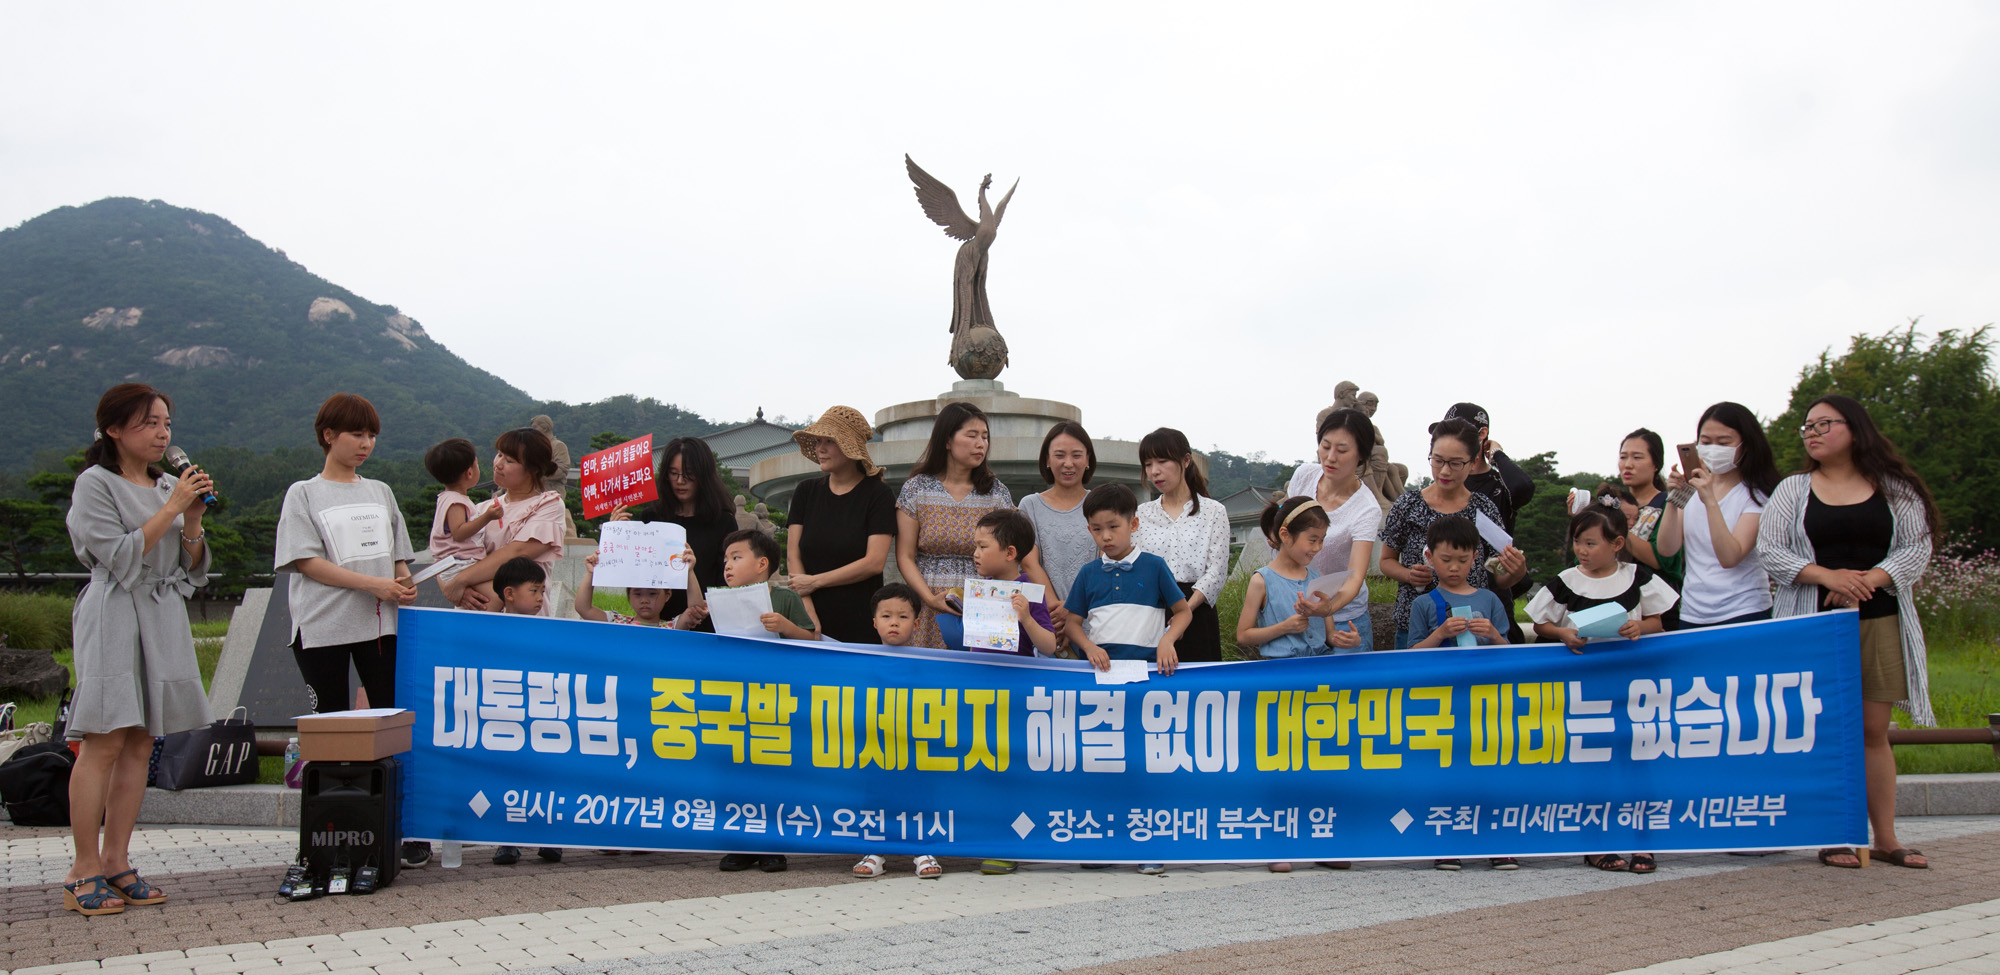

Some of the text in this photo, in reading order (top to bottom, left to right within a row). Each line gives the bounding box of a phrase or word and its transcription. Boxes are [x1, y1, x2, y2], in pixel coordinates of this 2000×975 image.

[583, 440, 650, 476] 엄마, 숨쉬기 힘들어요
[583, 466, 652, 501] 아빠, 나가서 놀고파요
[432, 666, 1823, 774] 대통령님, 중국발 미세먼지 해결 없이 대한민국 미래는 없습니다
[204, 741, 251, 776] GAP
[503, 789, 955, 843] 일시: 2017년 8월 2일 (수) 오전 11시
[1047, 807, 1337, 843] 장소: 청와대 분수대 앞
[1424, 805, 1480, 836] 주최
[1617, 799, 1673, 831] 해결
[1679, 794, 1788, 829] 시민본부
